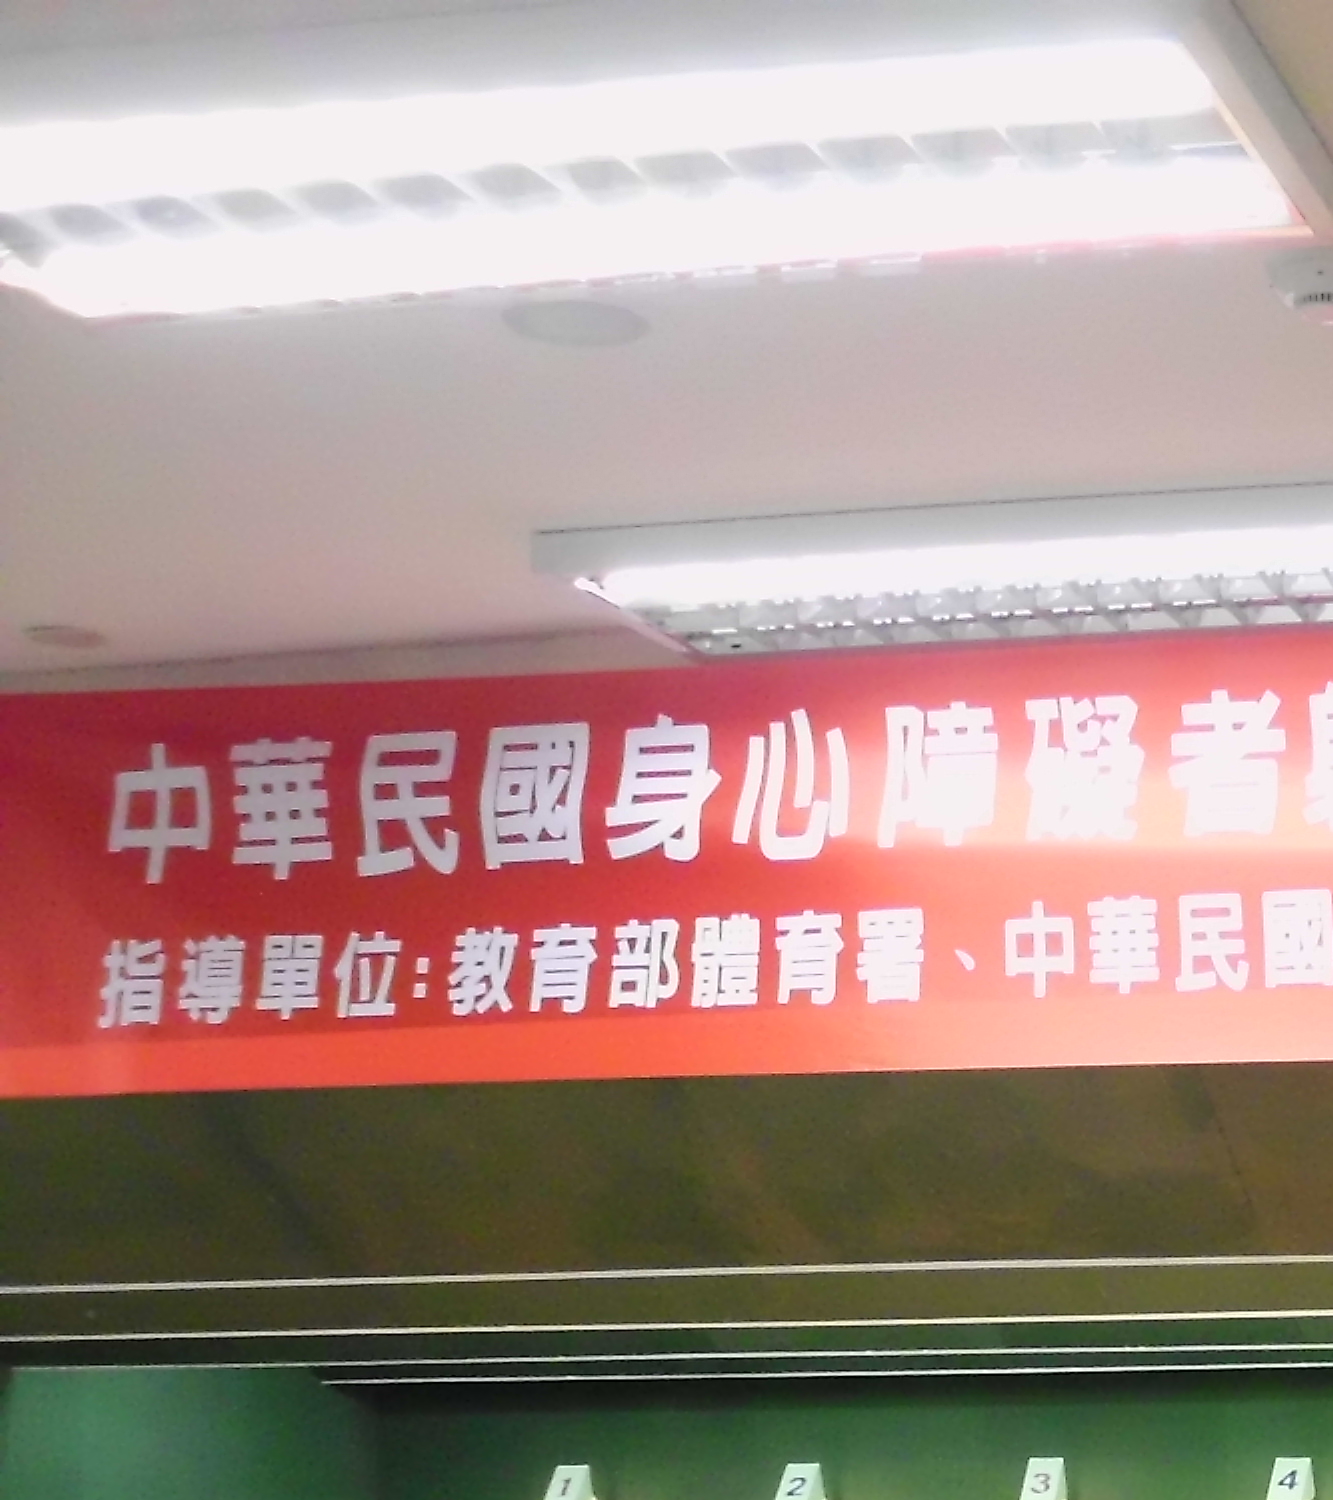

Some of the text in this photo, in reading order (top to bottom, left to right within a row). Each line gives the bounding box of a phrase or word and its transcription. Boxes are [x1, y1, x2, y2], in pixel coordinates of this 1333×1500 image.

[785, 1476, 808, 1497] 2
[1029, 1472, 1052, 1494] 3
[1277, 1468, 1299, 1491] 4
